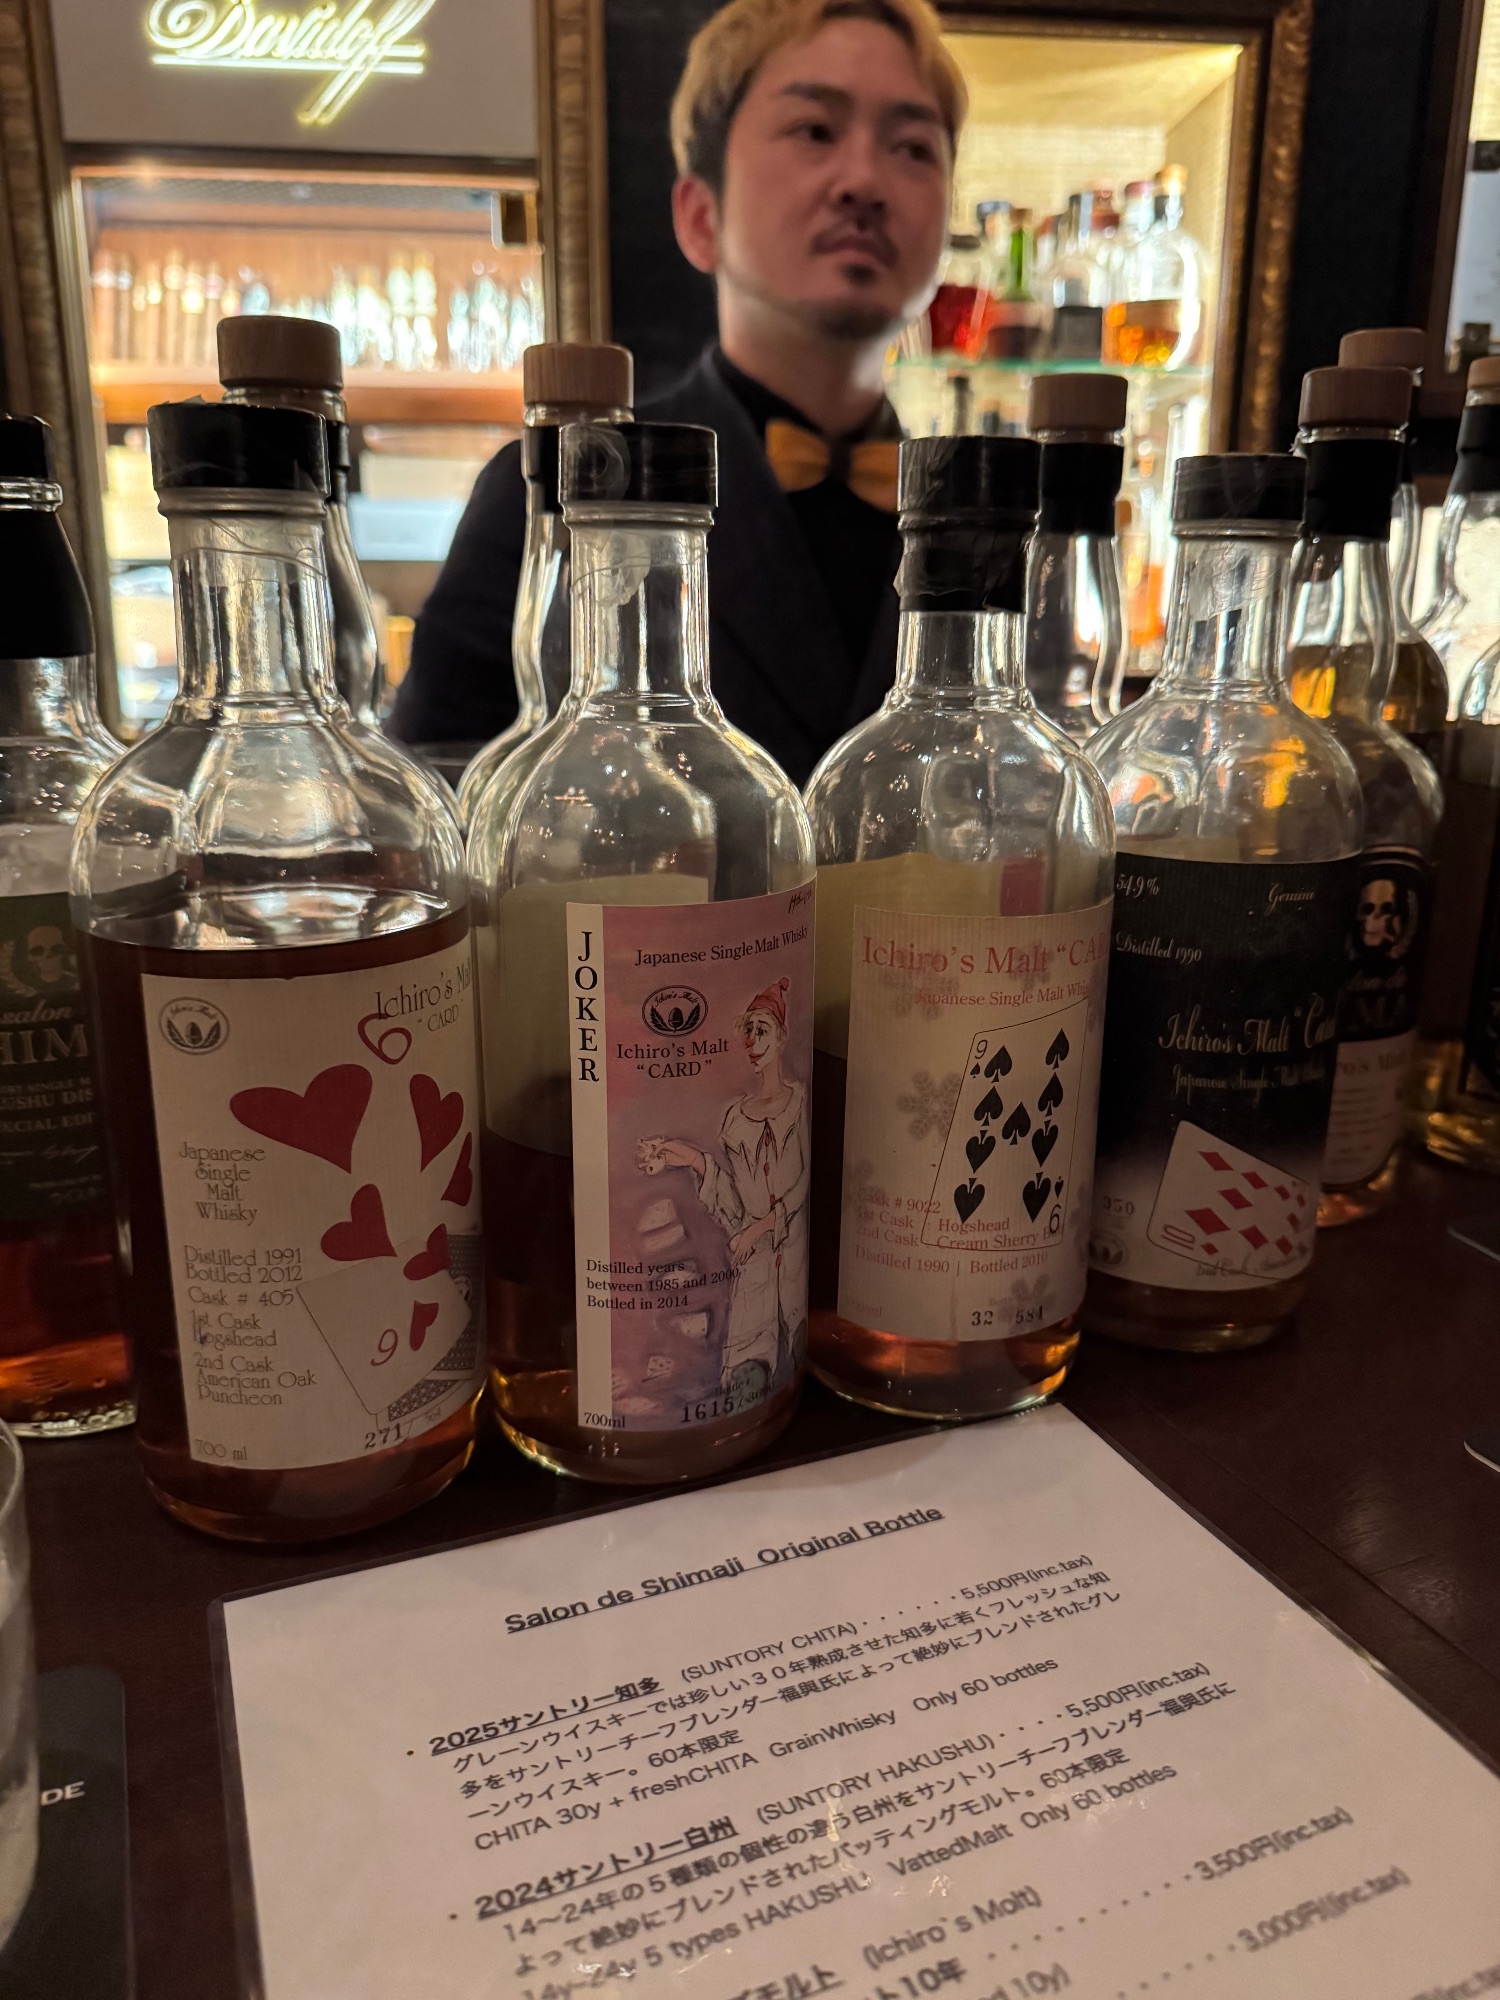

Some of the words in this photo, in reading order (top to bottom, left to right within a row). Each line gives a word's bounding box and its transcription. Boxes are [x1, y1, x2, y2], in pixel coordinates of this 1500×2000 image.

[635, 949, 706, 967] Japanese
[711, 944, 753, 961] Single
[754, 935, 781, 954] Malt
[782, 926, 809, 945] Whisky
[862, 936, 975, 974] Ichiro's
[984, 945, 1048, 974] Malt
[1116, 932, 1173, 959] Distilled
[374, 971, 453, 1020] Ichiro's
[575, 931, 600, 1082] JOKER
[916, 989, 985, 1007] Japanese
[990, 991, 1033, 1007] Single
[1037, 984, 1065, 1003] Malt
[358, 1013, 412, 1065] 6
[617, 1042, 684, 1059] Ichiro's
[692, 1038, 729, 1056] Malt
[974, 1040, 988, 1059] 9
[180, 1142, 265, 1161] Japanese
[195, 1162, 251, 1187] Single
[207, 1181, 243, 1201] Malt
[196, 1201, 258, 1226] Whisky
[895, 1198, 904, 1209] #
[907, 1199, 941, 1214] 9022
[879, 1211, 914, 1229] Cask
[938, 1218, 1011, 1235] Hogshead
[855, 1226, 879, 1239] 2nd
[884, 1229, 919, 1247] Cask
[937, 1235, 988, 1250] Cream
[993, 1229, 1038, 1249] Sherry
[184, 1245, 257, 1267] Distilled
[266, 1247, 303, 1265] 1991
[855, 1245, 911, 1270] Distilled
[917, 1258, 950, 1273] 1990
[970, 1255, 1018, 1274] Bottled
[186, 1262, 252, 1283] Bottled
[258, 1265, 303, 1283] 2012
[586, 1260, 643, 1275] Distilled
[648, 1261, 685, 1276] years
[586, 1277, 643, 1292] between
[648, 1278, 679, 1291] 1985
[683, 1271, 707, 1289] and
[188, 1286, 229, 1306] Cask
[237, 1294, 249, 1305] #
[258, 1288, 295, 1307] 405
[587, 1295, 636, 1310] Bottled
[640, 1298, 653, 1309] in
[657, 1295, 689, 1309] 2014
[192, 1310, 212, 1327] 1st
[218, 1312, 263, 1330] Cask
[971, 1311, 994, 1326] 32
[193, 1323, 277, 1350] Hogshead
[195, 1352, 224, 1370] 2nd
[231, 1355, 274, 1373] Cask
[197, 1369, 271, 1389] American
[278, 1369, 317, 1388] Oak
[198, 1384, 282, 1406] Puncheon
[584, 1412, 626, 1429] 700ml
[194, 1439, 227, 1458] 700
[233, 1444, 248, 1461] ml
[504, 1601, 590, 1633] Salon
[597, 1586, 635, 1609] de
[640, 1557, 746, 1597] Shimaji
[756, 1526, 863, 1567] Original
[863, 1506, 945, 1538] Bottle
[429, 1676, 662, 1755] 2025サントリー知多
[681, 1641, 785, 1683] (SUNTORY
[474, 1816, 553, 1851] CHITA
[556, 1800, 602, 1826] 30y
[609, 1796, 625, 1809] +
[631, 1752, 759, 1803] freshCHITA
[768, 1709, 898, 1759] GrainWhisky
[912, 1690, 958, 1713] Only
[961, 1678, 990, 1698] 60
[991, 1656, 1060, 1687] bottles
[475, 1815, 739, 1920] 2024サントリー白州
[757, 1771, 873, 1825] (SUNTORY
[643, 1945, 663, 1968] 5
[668, 1922, 742, 1960] types
[887, 1822, 1014, 1877] VattedMalt
[1020, 1802, 1070, 1829] Only
[1071, 1789, 1102, 1811] 60
[1107, 1762, 1178, 1800] bottles
